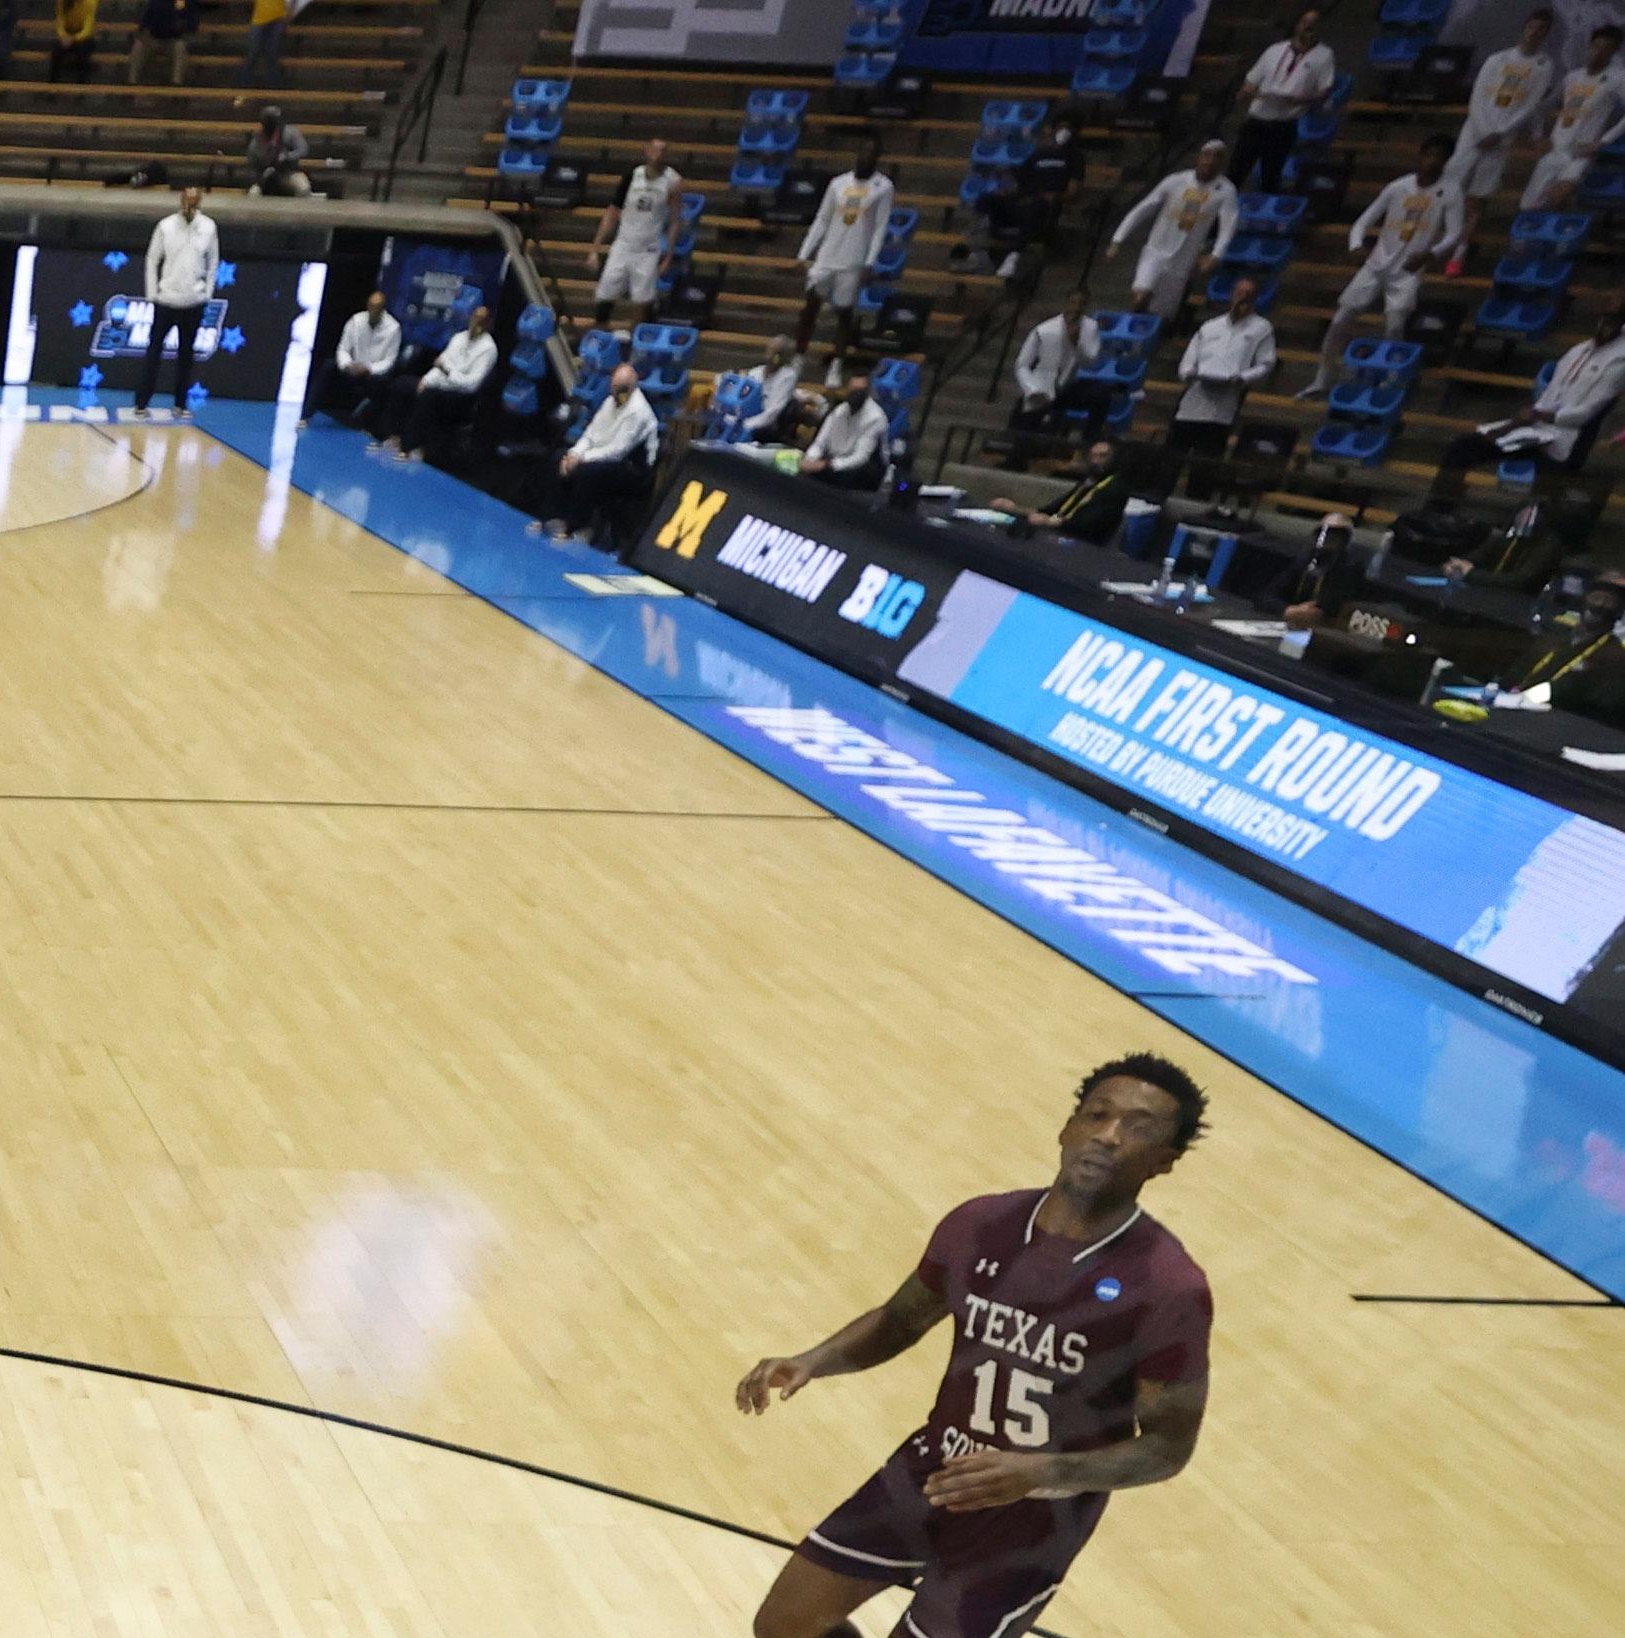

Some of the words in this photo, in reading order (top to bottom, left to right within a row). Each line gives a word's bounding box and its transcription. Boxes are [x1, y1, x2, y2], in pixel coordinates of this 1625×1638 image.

[716, 514, 848, 604] MICHIGAN
[1040, 629, 1167, 726] NCAA
[1132, 669, 1286, 772] FIRST
[1246, 717, 1442, 842] ROUND
[1048, 711, 1126, 764] HOSTED
[1106, 738, 1152, 774] BY
[1131, 749, 1220, 811] PURDUE
[1202, 780, 1330, 861] UNIVERSITY
[725, 703, 955, 786] WEST
[859, 783, 1320, 985] LAFAYETTE
[963, 1293, 1088, 1375] TEXAS
[969, 1359, 1054, 1448] 15
